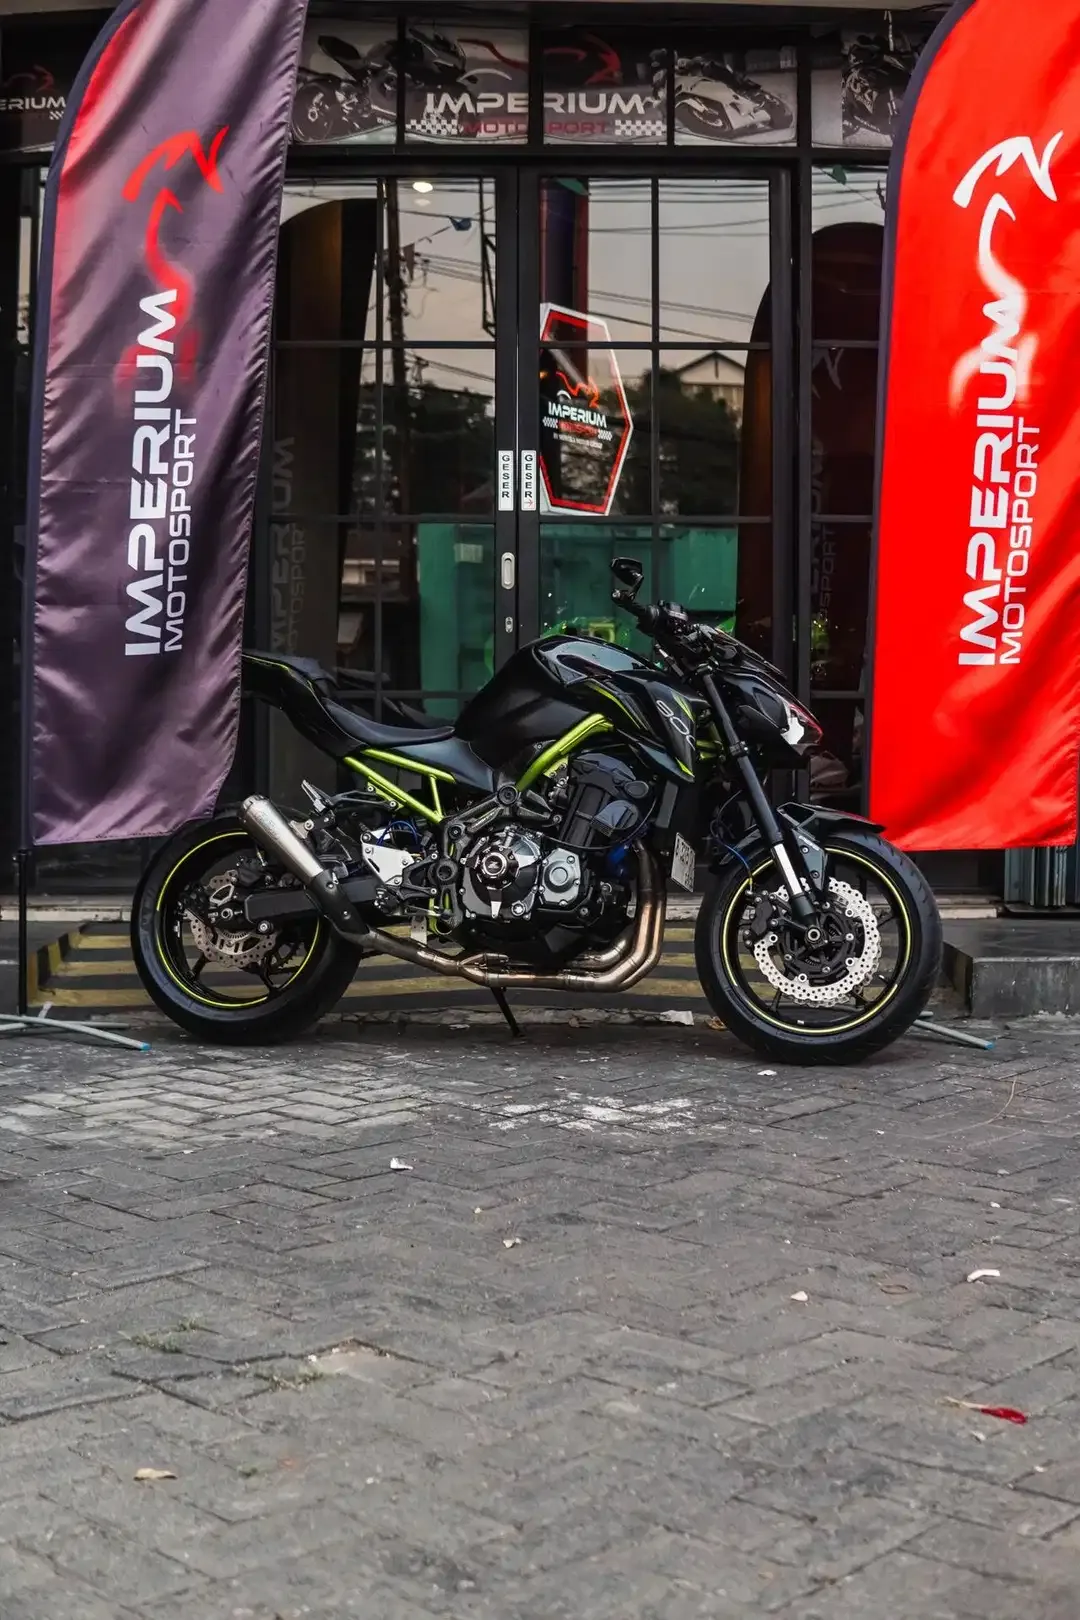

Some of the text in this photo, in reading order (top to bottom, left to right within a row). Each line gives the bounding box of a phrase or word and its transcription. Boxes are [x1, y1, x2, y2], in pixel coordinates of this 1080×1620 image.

[426, 92, 645, 115] IMPERIUM
[463, 122, 606, 135] MOTOPORT
[548, 401, 607, 428] IMPERIUM
[125, 288, 178, 656] IMPERIUM
[501, 454, 511, 499] GESER
[524, 454, 534, 499] GESER
[958, 299, 1020, 666] IMPERIUM
[164, 408, 197, 652] MOTOSPORT
[999, 416, 1040, 665] MOTOSPORT
